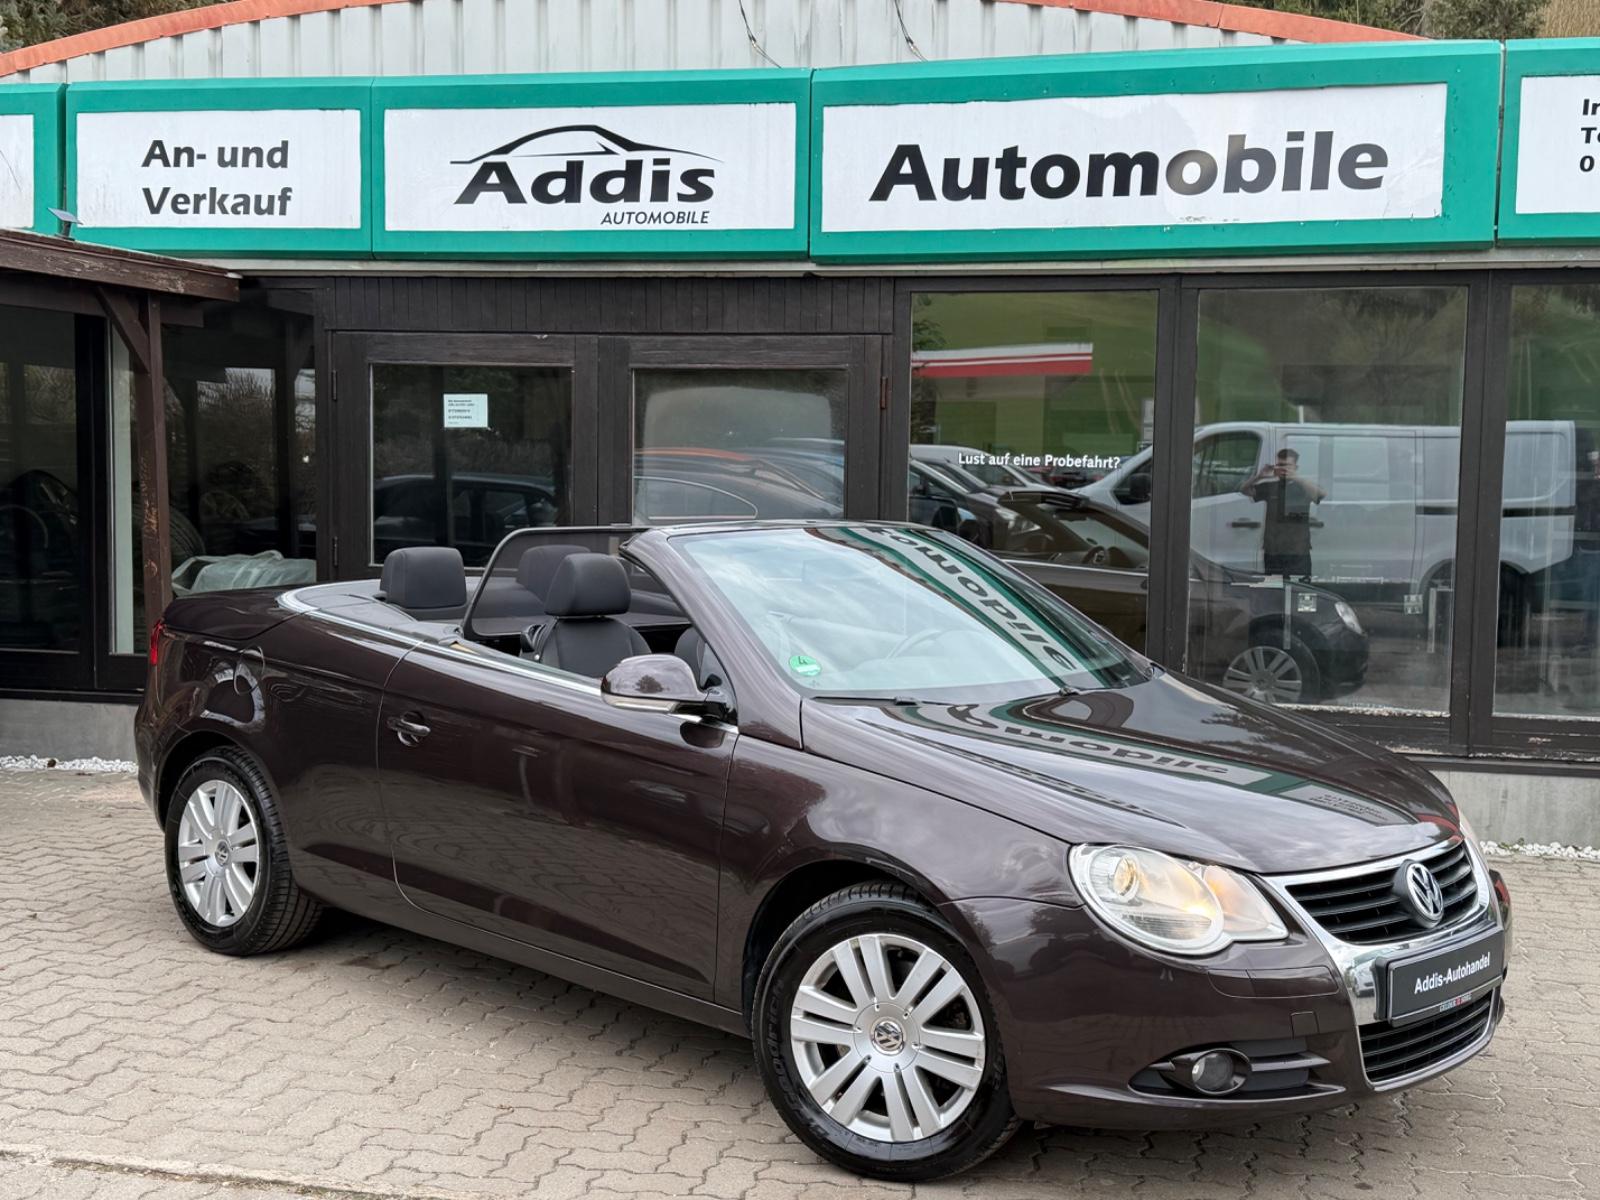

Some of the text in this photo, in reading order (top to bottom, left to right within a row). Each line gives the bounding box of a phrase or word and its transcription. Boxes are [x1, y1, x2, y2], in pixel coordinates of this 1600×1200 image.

[1580, 127, 1600, 144] T
[142, 139, 289, 168] An- und
[868, 131, 1388, 202] Automobile
[455, 158, 714, 205] Addis
[142, 186, 293, 216] Verkauf
[600, 211, 710, 225] AUTOMOBILE
[958, 452, 1120, 469] Lust auf eine Probefahrt?
[1413, 951, 1491, 995] Addis-Autohandel
